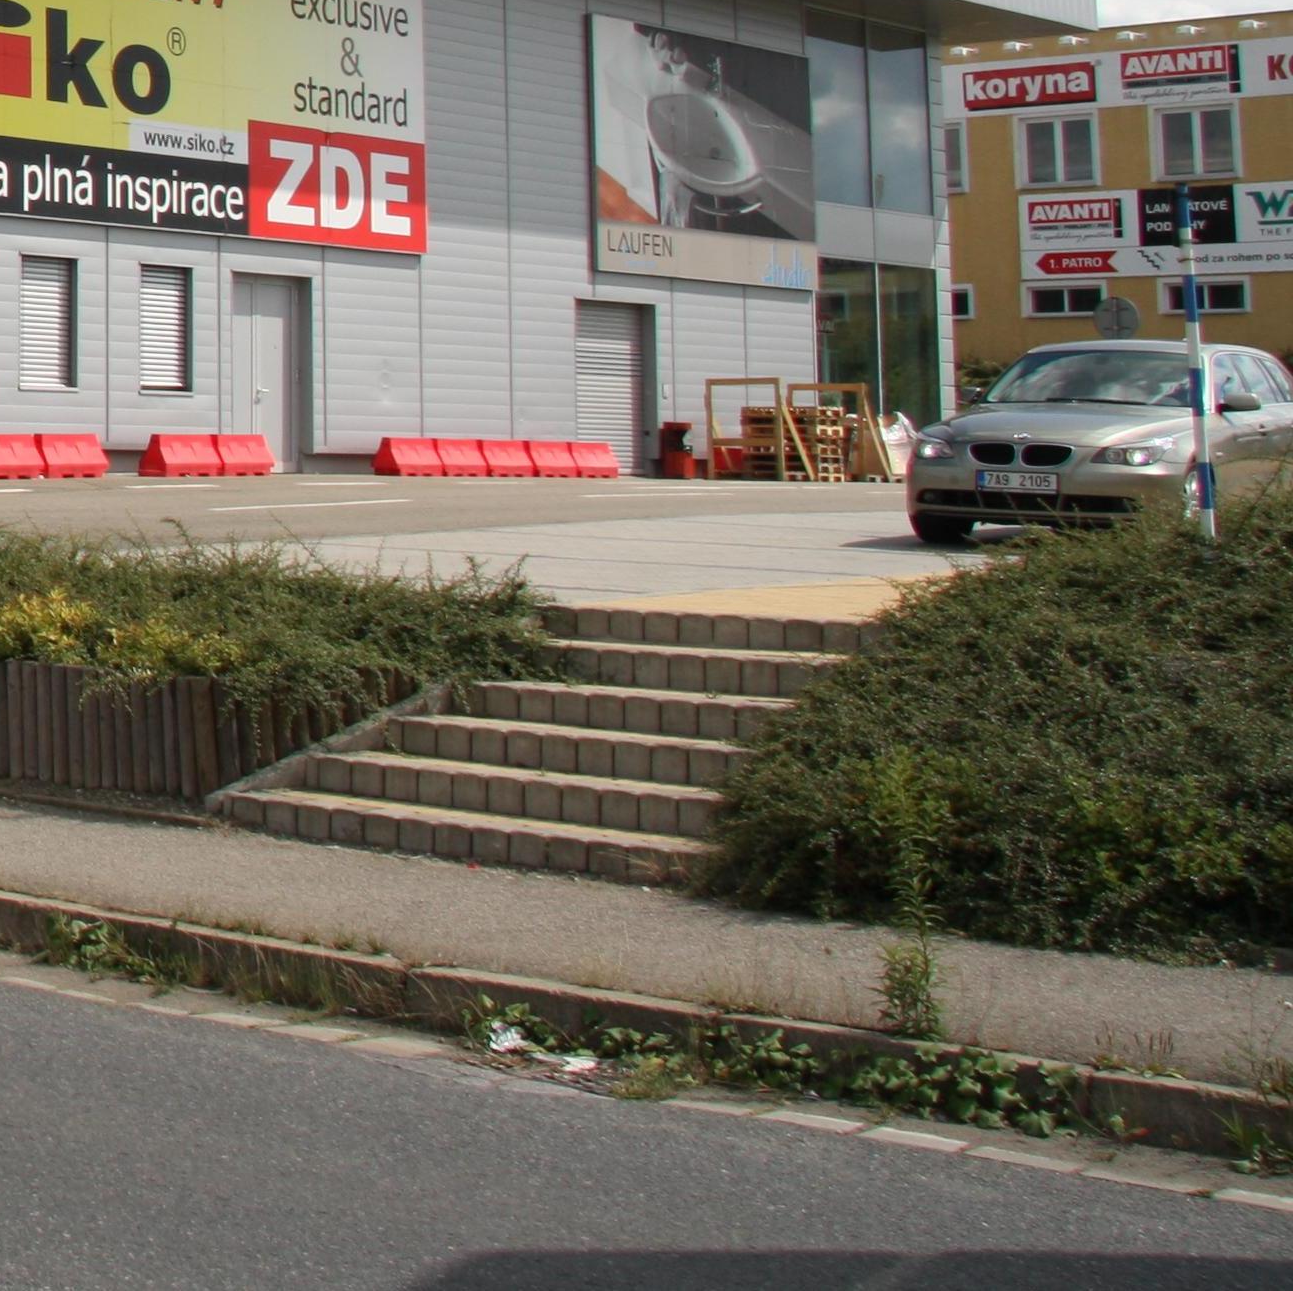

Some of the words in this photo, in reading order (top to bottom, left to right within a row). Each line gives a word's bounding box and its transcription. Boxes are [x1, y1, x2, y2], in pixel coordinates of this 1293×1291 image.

[340, 36, 364, 78] &
[1124, 49, 1223, 76] AVANTI
[964, 70, 1090, 102] koryna
[293, 75, 408, 128] standard
[143, 130, 236, 157] www.siko.cz
[22, 153, 94, 212] plná
[107, 162, 244, 223] inspirace
[266, 138, 412, 237] ZDE
[1030, 202, 1110, 221] AVANTI
[607, 228, 673, 257] LAUFEN
[1260, 227, 1281, 236] THE
[1061, 257, 1102, 268] PATRO
[1212, 254, 1226, 263] za
[1227, 252, 1263, 262] rohem
[1266, 253, 1280, 264] po
[987, 473, 1010, 486] 7A9
[1018, 474, 1051, 488] 2105
